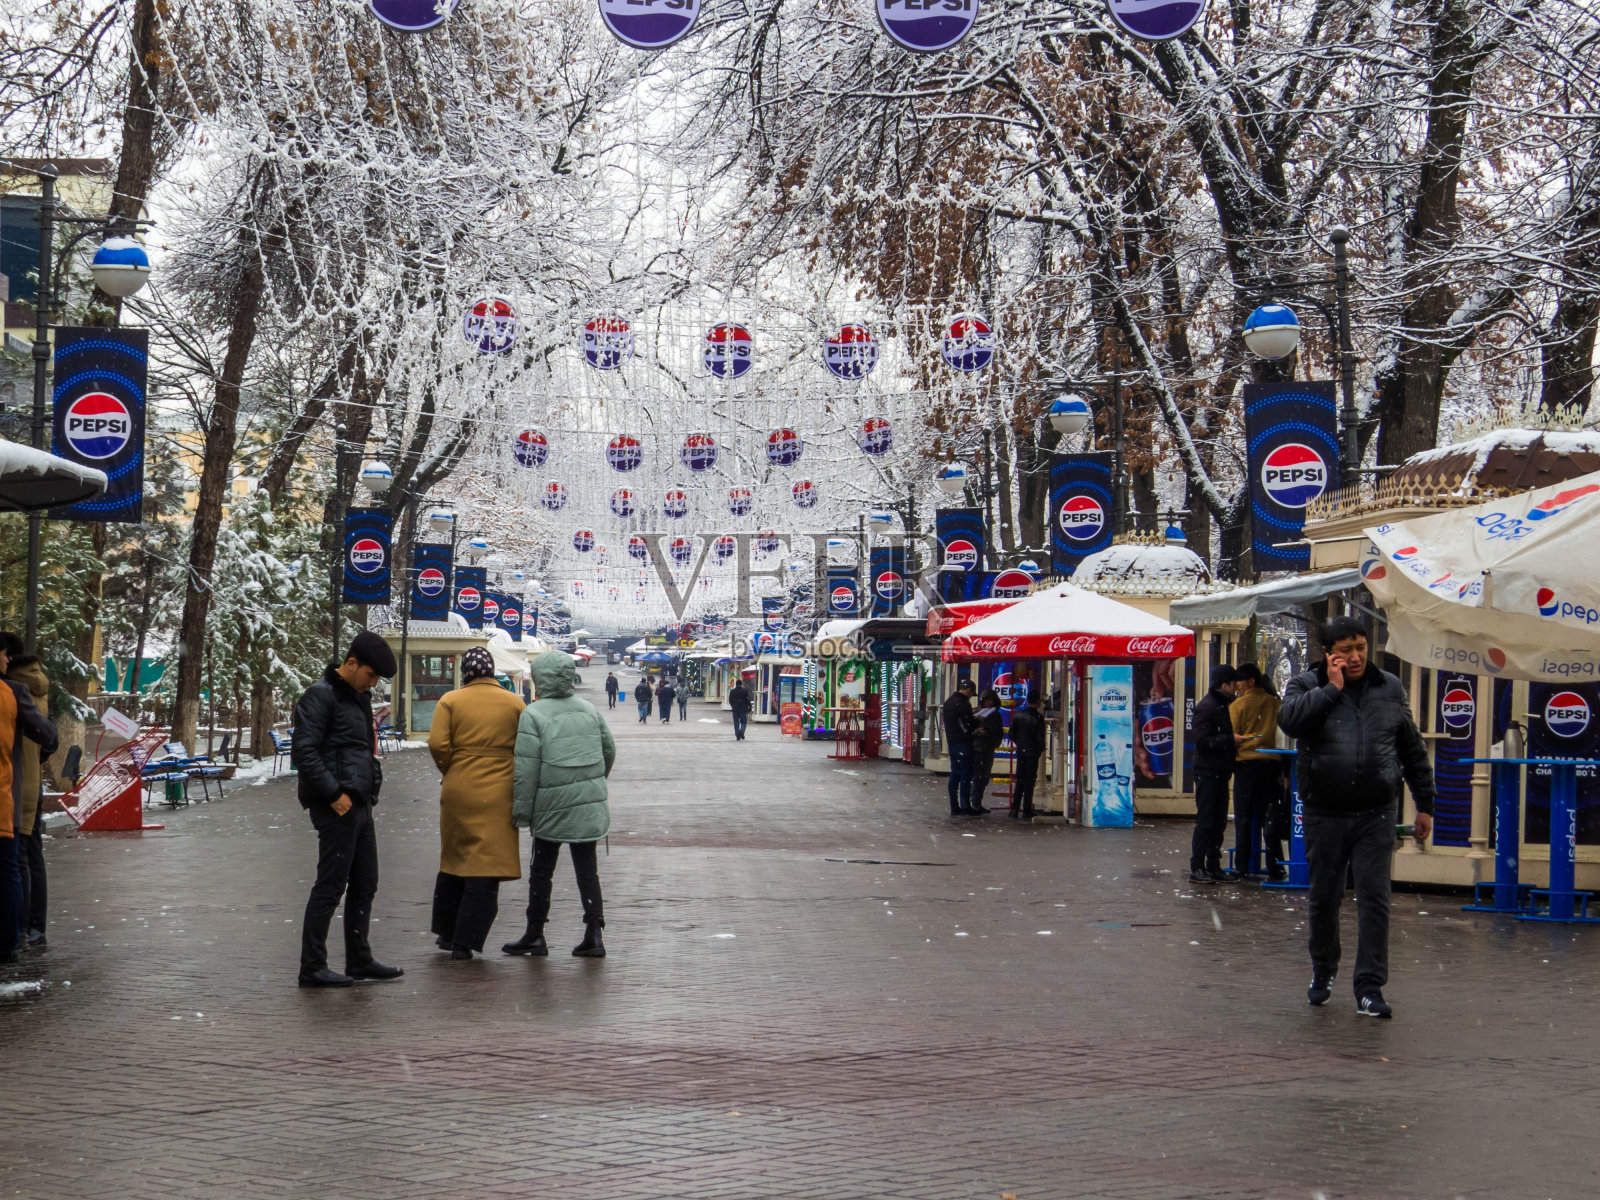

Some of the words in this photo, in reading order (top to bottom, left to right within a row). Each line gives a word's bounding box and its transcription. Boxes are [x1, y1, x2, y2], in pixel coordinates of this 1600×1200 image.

[69, 418, 127, 434] PEPSI
[1266, 468, 1323, 483] PEPSI
[1062, 512, 1101, 523] PEPSI
[353, 552, 382, 560] PEPSI
[947, 553, 975, 561] PEPSI
[419, 578, 443, 586] PEPSI
[971, 637, 1019, 654] Coca-Cola
[1048, 636, 1098, 653] Coca-Cola
[1126, 637, 1176, 654] Coca-Cola
[1186, 697, 1194, 730] PEPSI
[1443, 704, 1473, 713] PEPSI
[1547, 709, 1587, 720] PEPSI
[1143, 730, 1174, 742] PEPS
